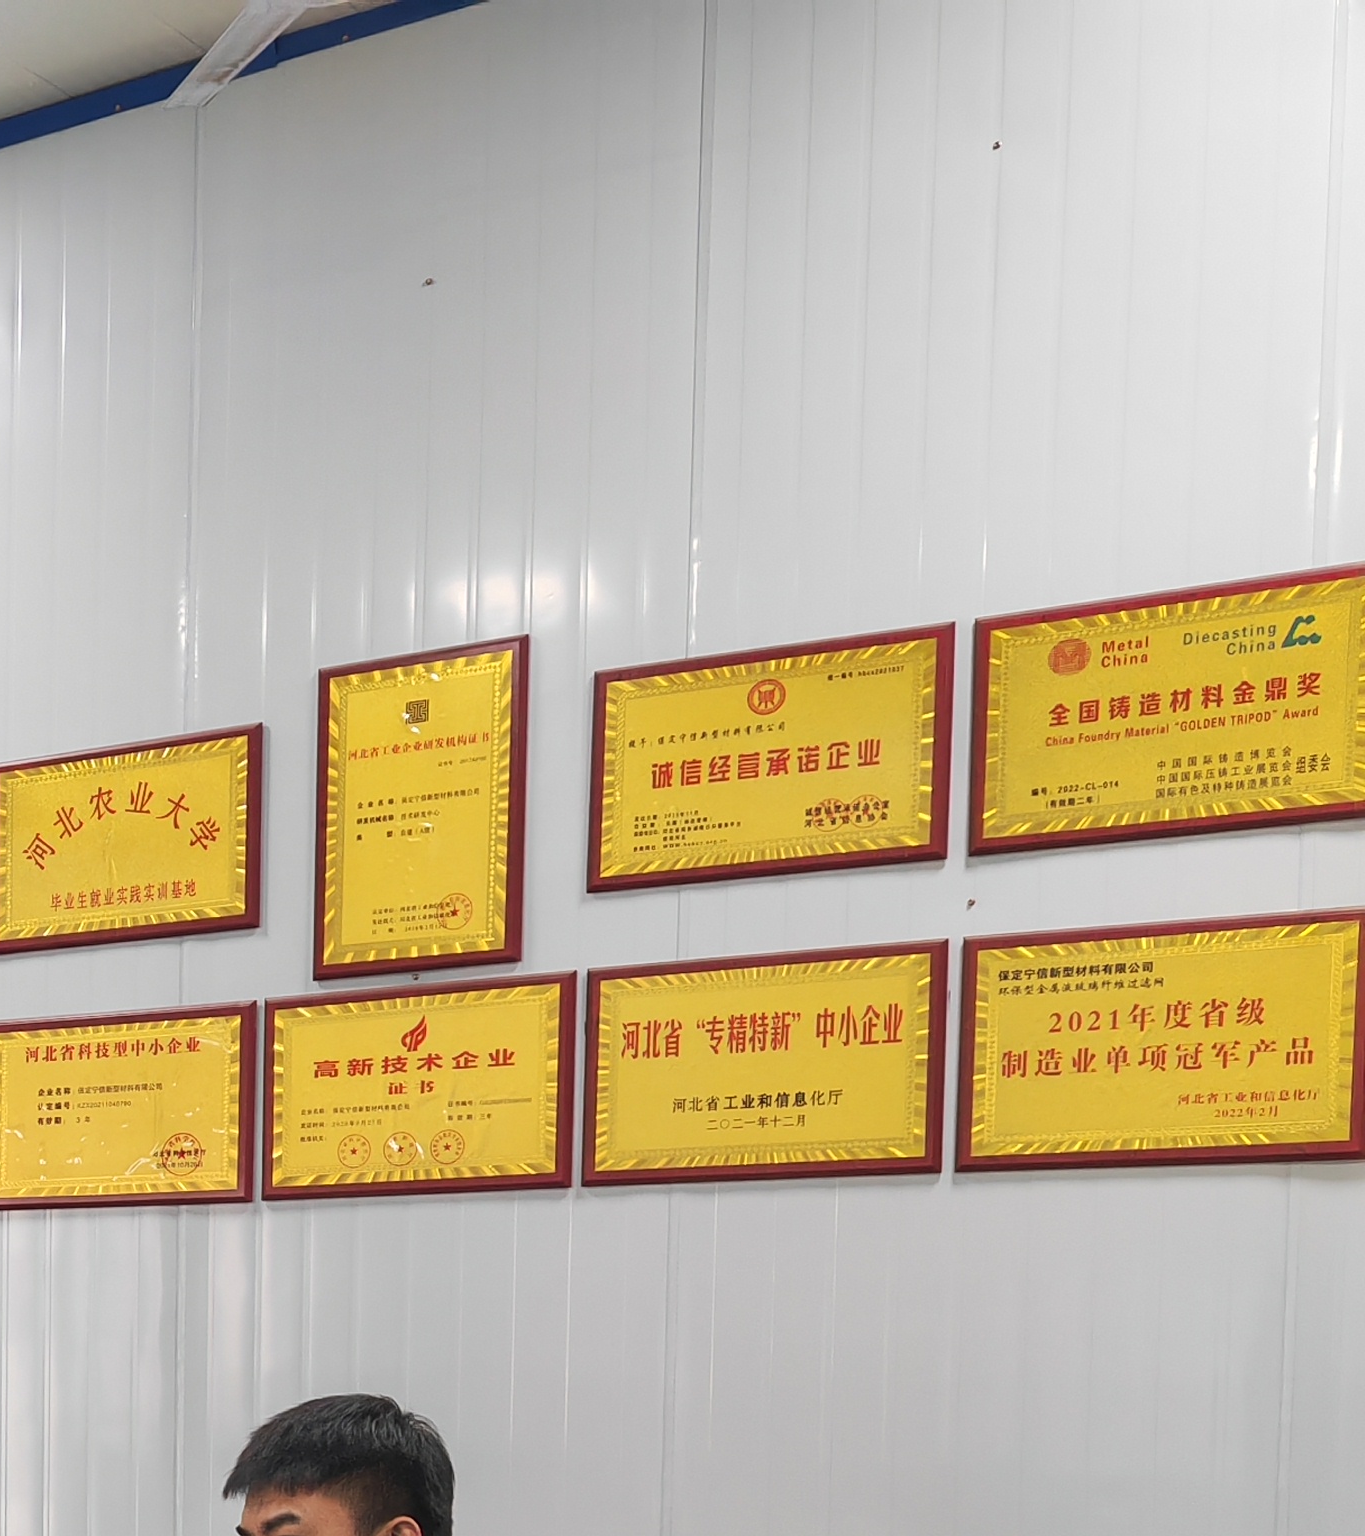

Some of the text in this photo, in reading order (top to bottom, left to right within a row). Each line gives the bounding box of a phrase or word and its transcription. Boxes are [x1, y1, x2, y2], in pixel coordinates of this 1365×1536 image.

[1101, 636, 1150, 654] Metal
[1183, 622, 1278, 647] Diecasting
[1225, 639, 1277, 656] China
[1100, 652, 1150, 669] China
[1047, 672, 1322, 728] 全国铸造材料金鼎奖
[1044, 733, 1075, 748] China
[1078, 729, 1121, 745] Foundry
[1124, 723, 1170, 739] Material
[1282, 705, 1320, 720] Award
[651, 738, 882, 790] 诚信经营承诺企业
[1156, 745, 1293, 771] 中国国际铸造博览会
[1156, 760, 1293, 785] 中国国际压铸工业展览会
[1155, 775, 1293, 799] 国际有色及特种铸造展览会
[23, 781, 222, 870] 河北农业大学
[49, 879, 198, 912] 毕业生就业实践实训基地
[998, 961, 1154, 982] 保定宁信新型材料有限公司
[1048, 996, 1267, 1035] 2021年度省级
[24, 1036, 202, 1064] 河北省科技型中小企业
[1000, 1036, 1316, 1079] 制造业单项冠军产品
[313, 1048, 516, 1079] 高新技术企业
[387, 1080, 435, 1096] 证书
[672, 1088, 844, 1113] 河北省工业和信息化厅
[1178, 1088, 1320, 1106] 河北省工业和信息化厅
[1213, 1105, 1279, 1118] 2022年2月
